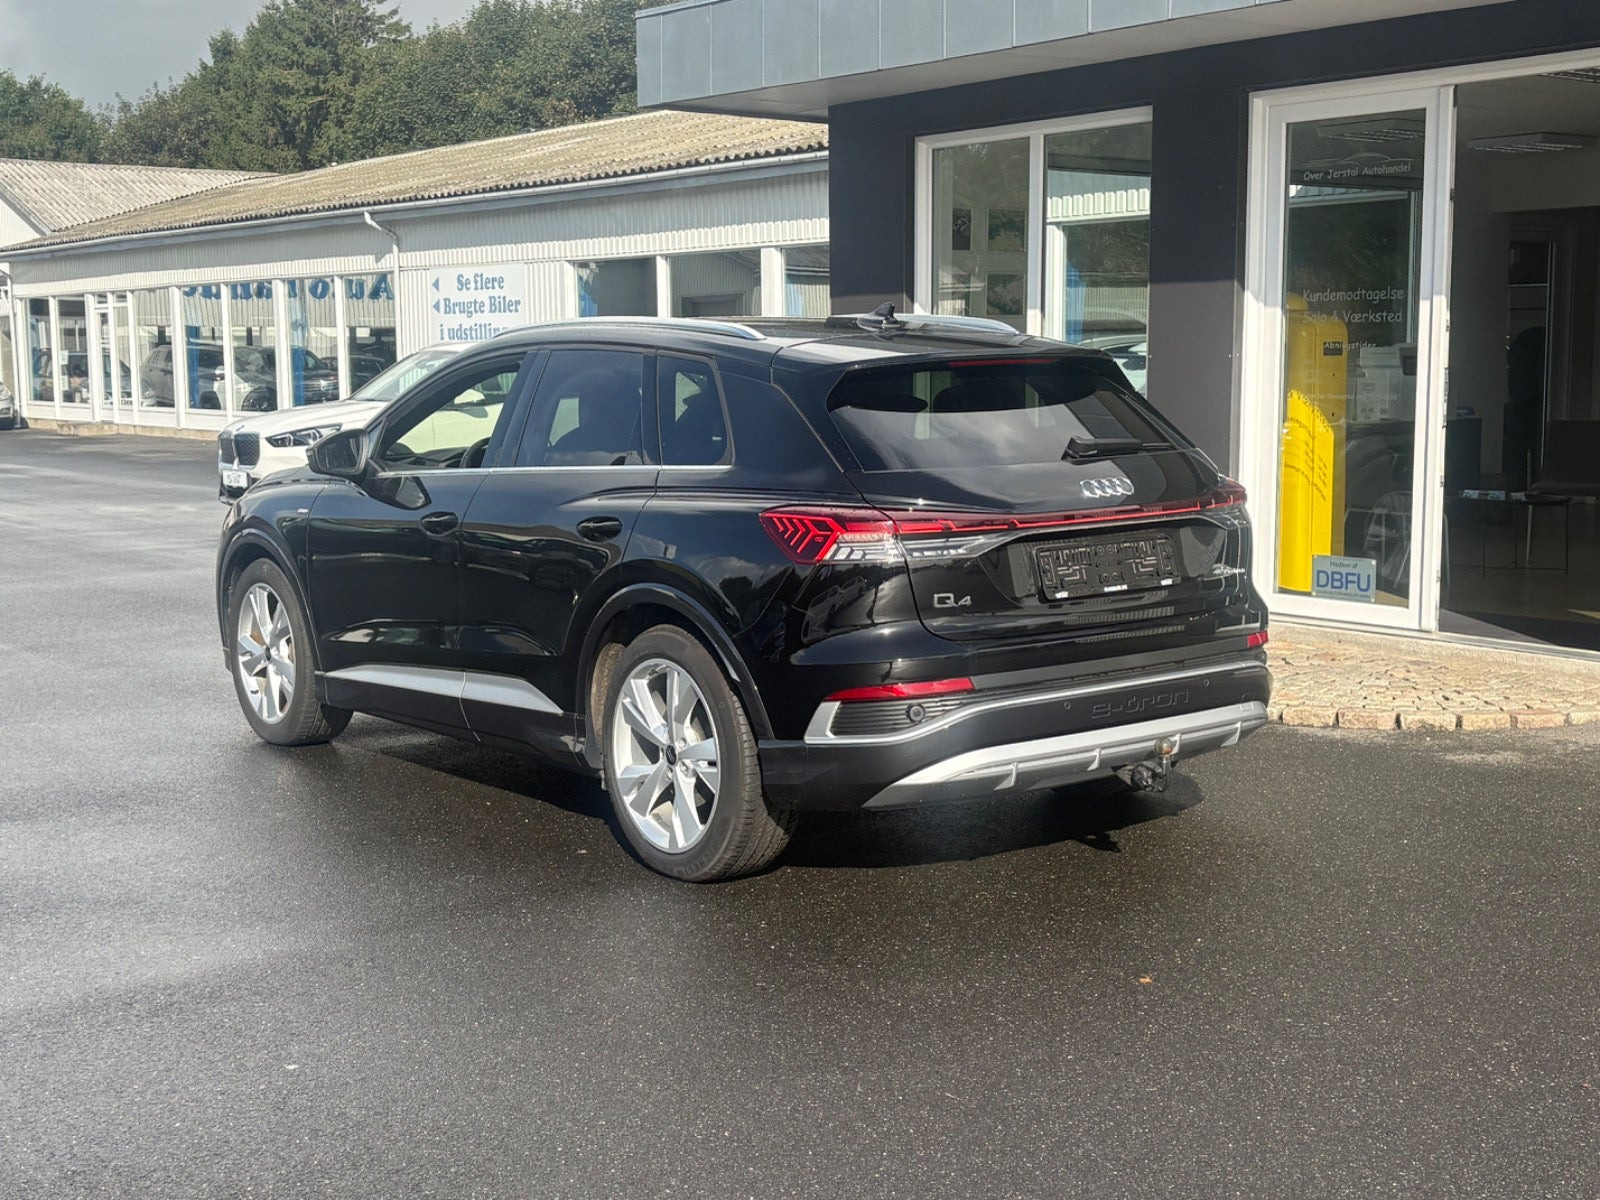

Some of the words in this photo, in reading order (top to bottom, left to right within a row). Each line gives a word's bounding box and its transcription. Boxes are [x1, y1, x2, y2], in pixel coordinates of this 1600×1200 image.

[1303, 171, 1325, 181] Over
[1327, 166, 1359, 179] Jerstal
[1362, 162, 1412, 176] Autohandel
[456, 273, 471, 291] Se
[473, 272, 505, 291] flere
[1302, 285, 1405, 304] Kundemodtagelse
[443, 297, 485, 318] Brugte
[488, 295, 521, 313] Biler
[1302, 310, 1327, 326] Salg
[1330, 310, 1341, 323] &
[1342, 308, 1403, 323] Værksted
[439, 323, 445, 341] i
[1316, 570, 1371, 592] DBFU
[933, 592, 972, 608] Q4
[1091, 689, 1190, 719] e-tron
